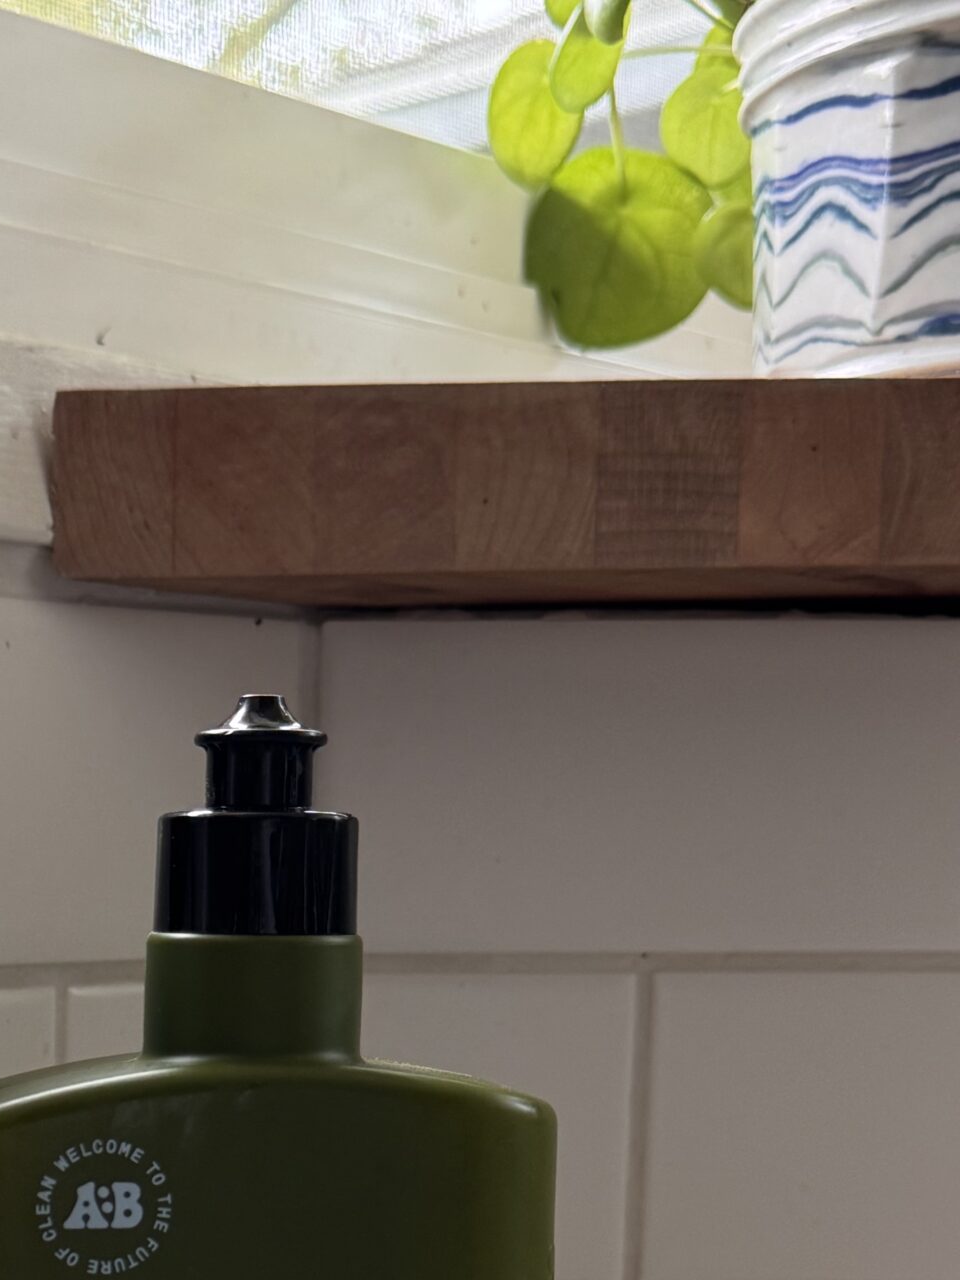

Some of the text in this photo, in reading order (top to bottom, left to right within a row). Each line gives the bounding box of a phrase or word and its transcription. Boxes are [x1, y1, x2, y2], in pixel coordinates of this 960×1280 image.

[36, 1139, 172, 1275] WELCOME TO THE FUTURE OF CLEAN
